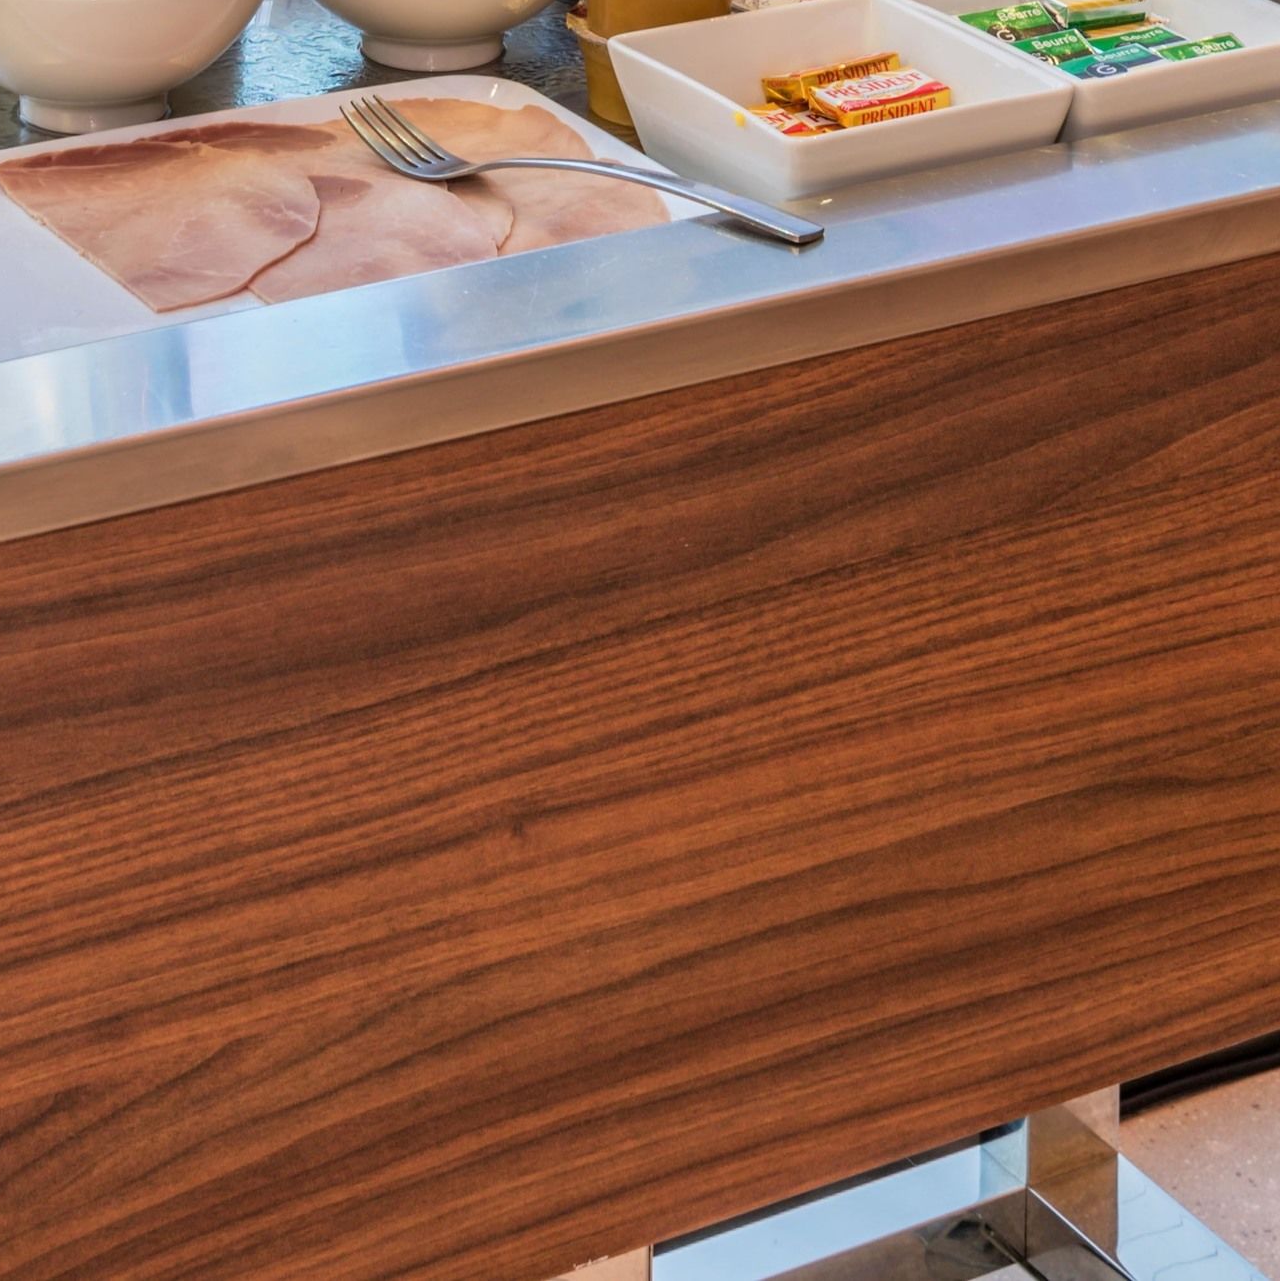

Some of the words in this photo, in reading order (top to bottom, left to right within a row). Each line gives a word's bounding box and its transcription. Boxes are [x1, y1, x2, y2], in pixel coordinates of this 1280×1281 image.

[996, 7, 1042, 22] Beurre
[1031, 31, 1078, 50] Beurre
[1120, 27, 1165, 42] Beurre
[1093, 46, 1141, 61] Beurre
[1191, 38, 1236, 55] Beurre
[825, 70, 923, 100] PRÉSIDENT
[861, 96, 937, 125] PRÉSIDENT
